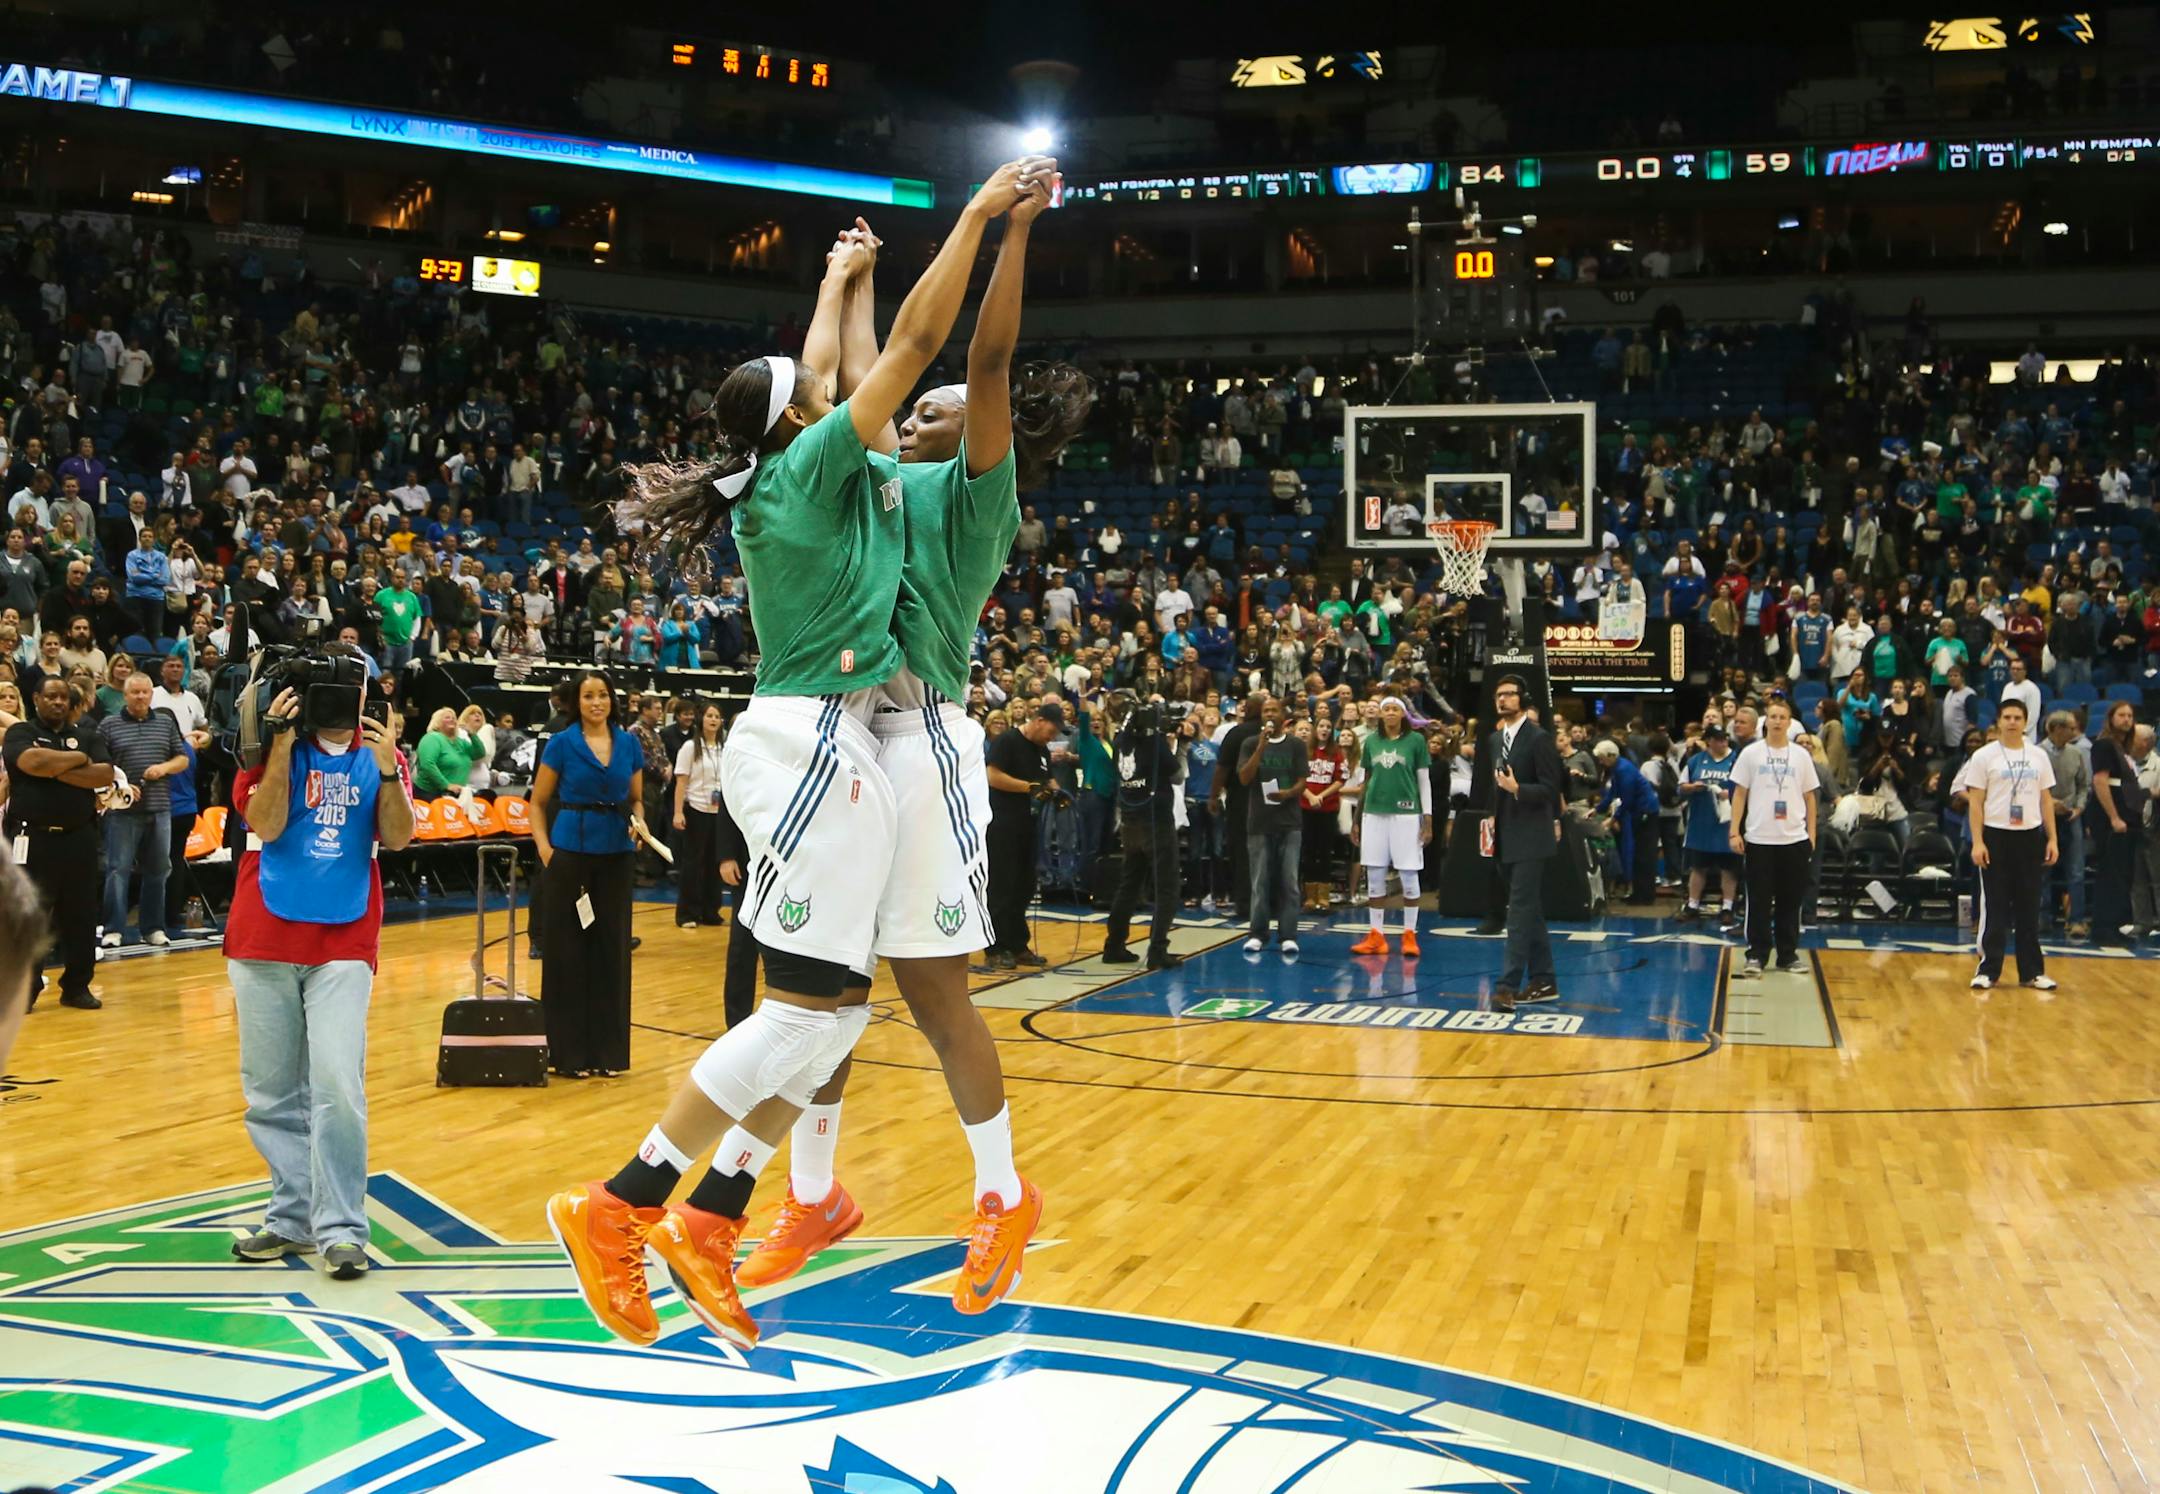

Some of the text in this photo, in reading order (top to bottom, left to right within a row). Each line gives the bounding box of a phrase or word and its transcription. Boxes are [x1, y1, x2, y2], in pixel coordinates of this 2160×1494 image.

[0, 64, 131, 108] AME 1
[351, 115, 405, 136] LYNX
[481, 132, 513, 148] 2013
[520, 137, 600, 159] PLAYOFFS
[1977, 142, 2014, 151] FOULS
[2063, 138, 2152, 150] MN FGM/FGA
[1673, 154, 1695, 163] QTR
[1746, 153, 1790, 173] 59
[1950, 152, 2004, 168] 0 0
[2069, 152, 2080, 163] 4
[1460, 165, 1505, 184] 84
[1597, 157, 1660, 180] 0.0
[1676, 164, 1691, 178] 4
[1256, 173, 1290, 181] FOULS
[1100, 182, 1118, 190] MN
[1266, 182, 1280, 194] 5
[1303, 181, 1311, 193] 1
[1102, 186, 1242, 202] 4 1/2 0 0 2
[1456, 251, 1494, 279] 0.0
[1613, 291, 1635, 301] 101
[1492, 654, 1533, 664] SPALDING
[1585, 658, 1601, 666] ALL
[1605, 658, 1624, 666] THE
[314, 804, 346, 826] 2013
